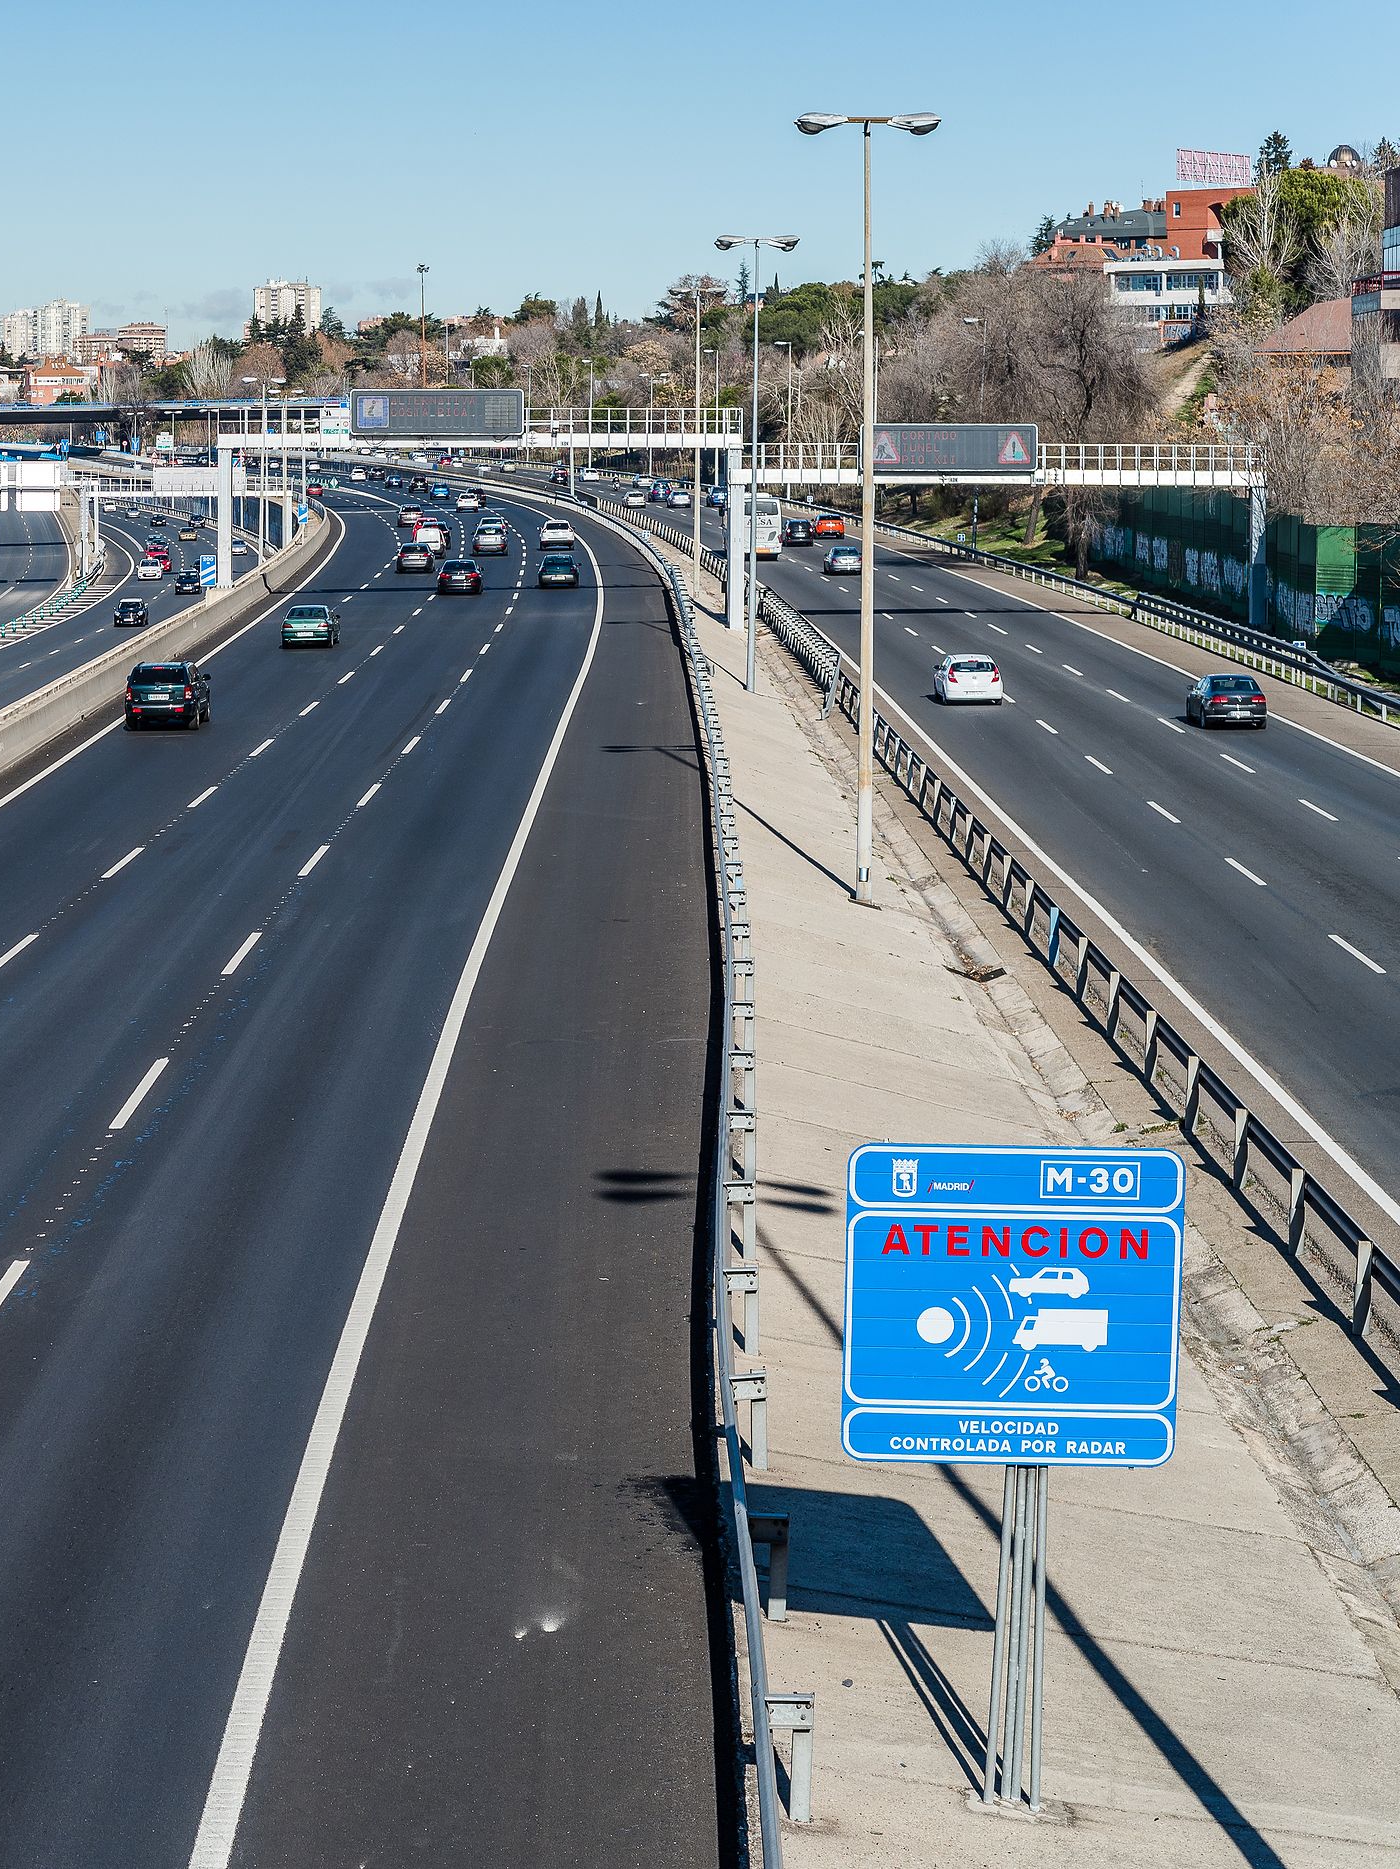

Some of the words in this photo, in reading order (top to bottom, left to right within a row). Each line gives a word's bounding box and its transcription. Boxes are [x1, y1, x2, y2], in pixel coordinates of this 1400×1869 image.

[902, 431, 957, 440] CORTADO
[902, 443, 940, 452] TUNEL
[901, 455, 925, 464] PIO
[1046, 1167, 1135, 1194] M-30
[881, 1223, 1150, 1260] ATENCION
[958, 1420, 1060, 1436] VELOCIDAD
[889, 1436, 1012, 1454] CONTROLADA
[1020, 1439, 1056, 1455] POR
[1066, 1439, 1127, 1455] RADAR
